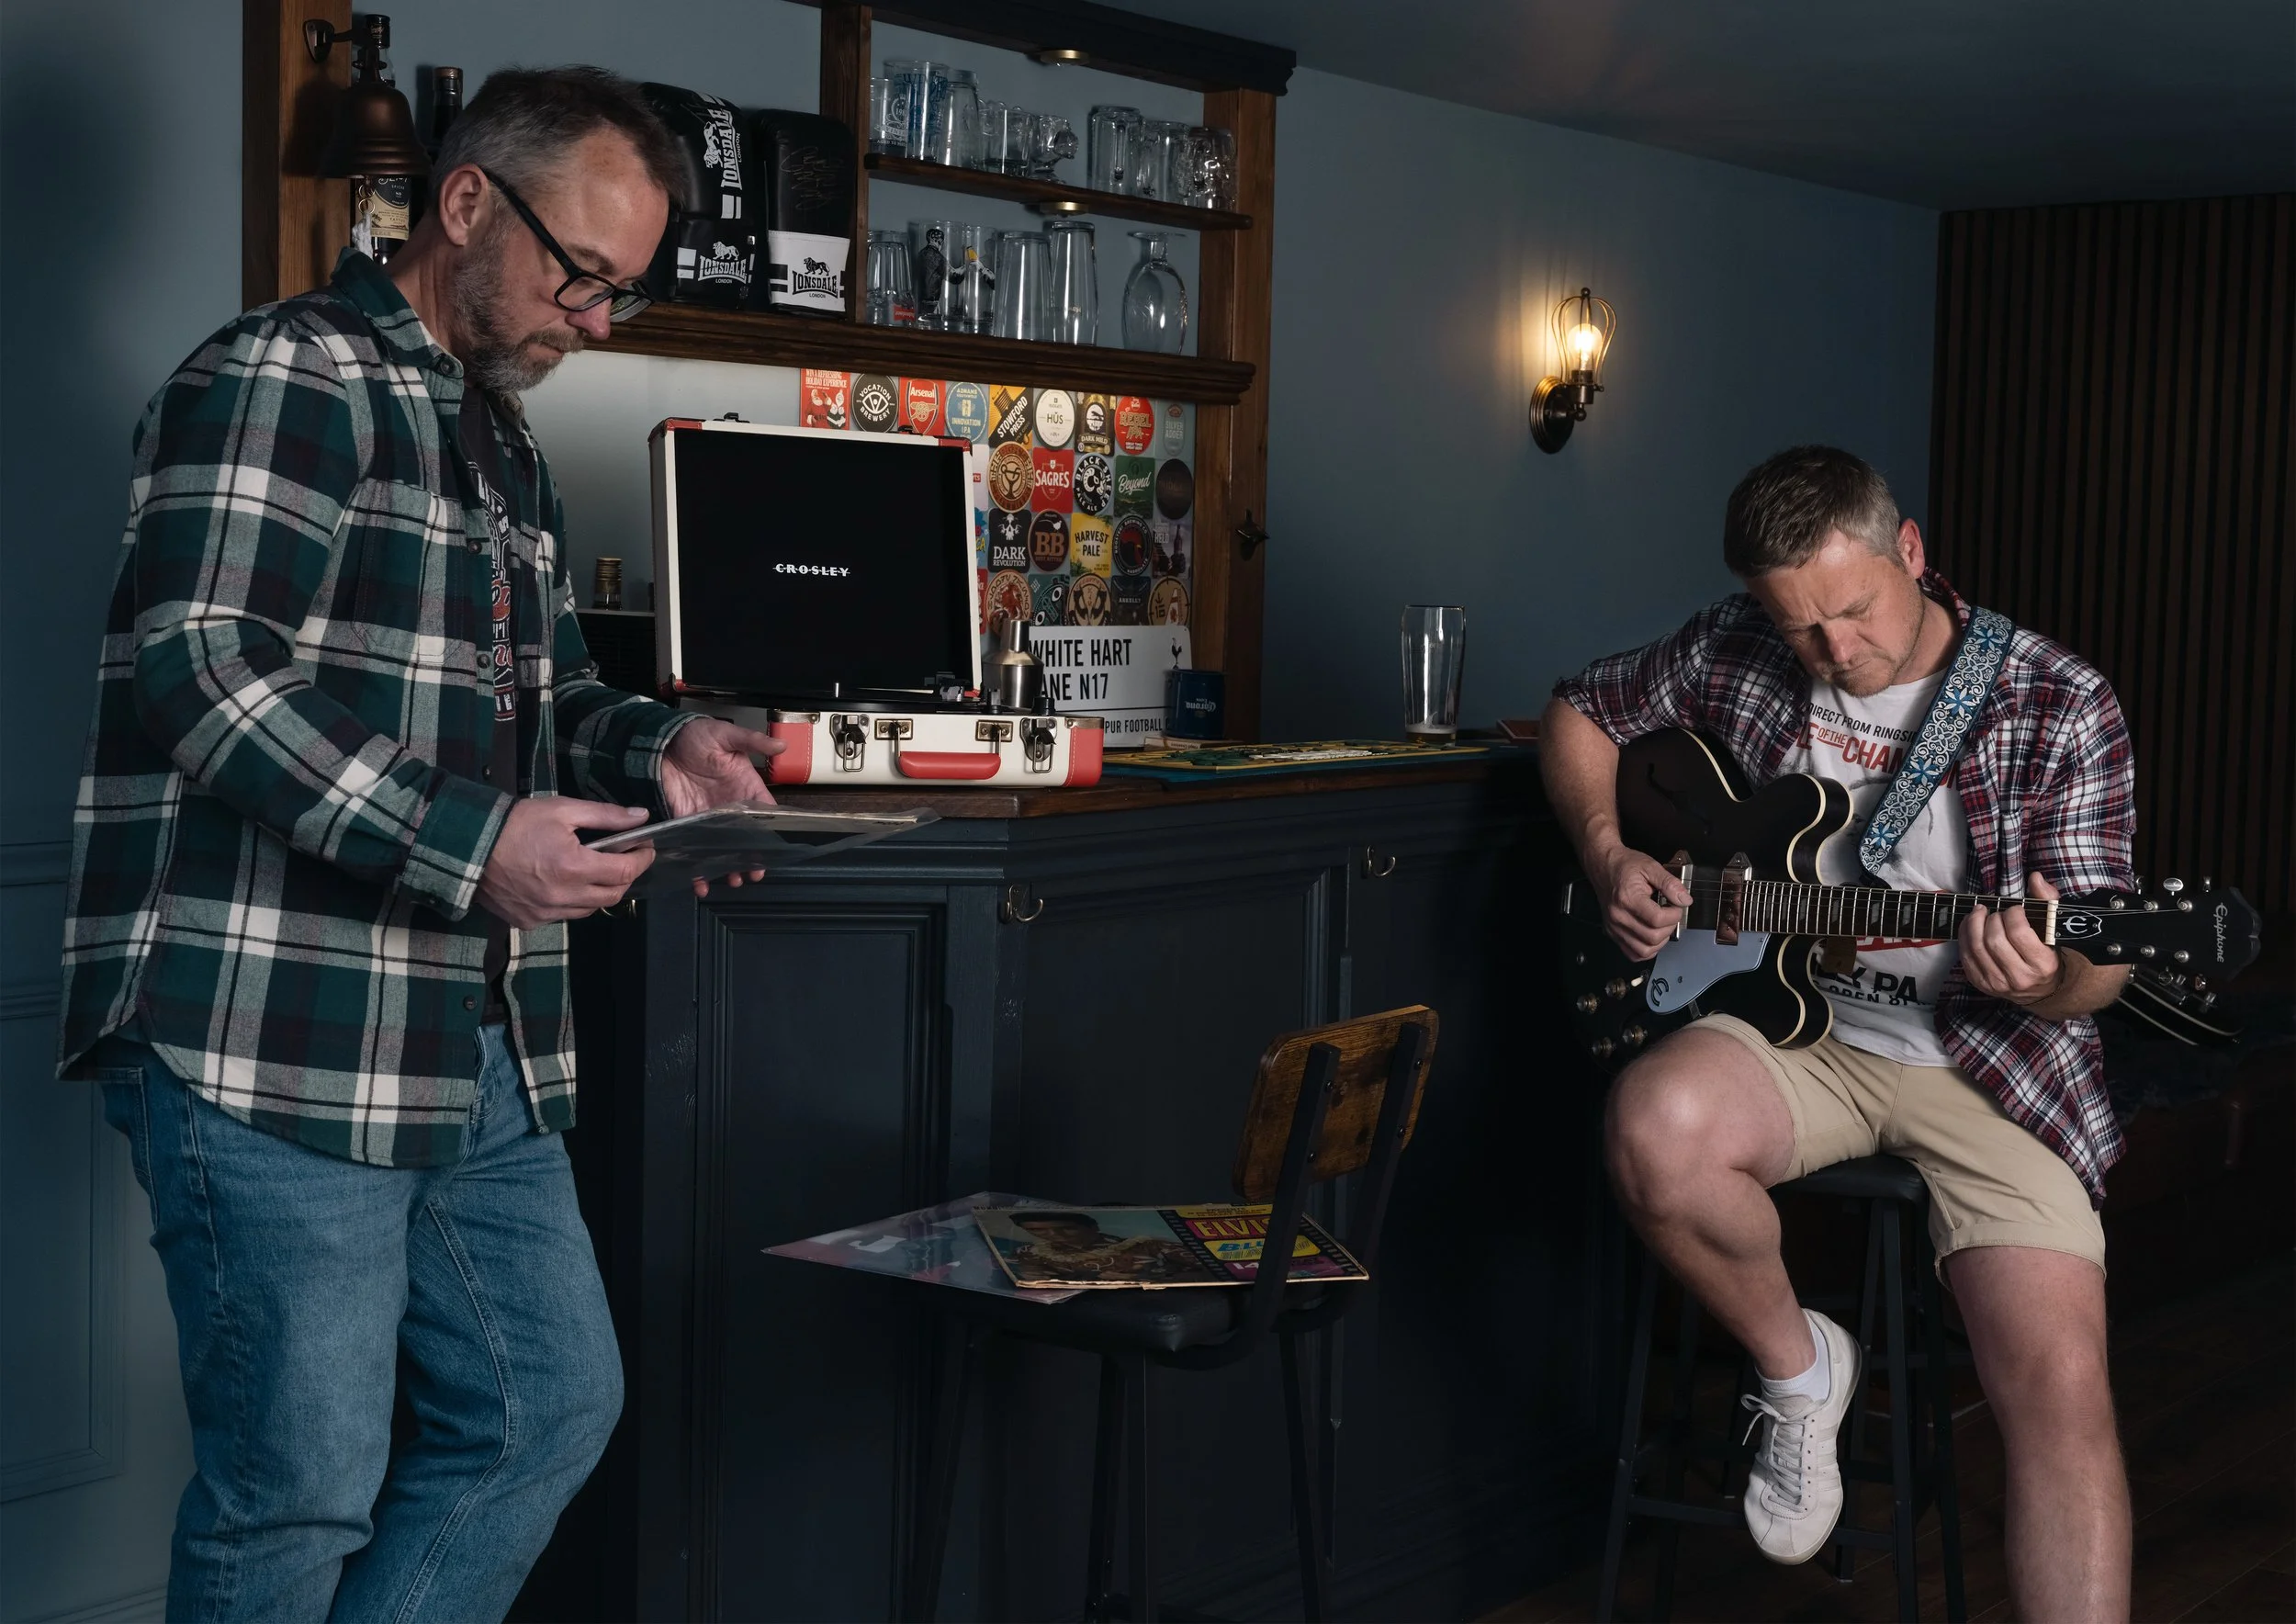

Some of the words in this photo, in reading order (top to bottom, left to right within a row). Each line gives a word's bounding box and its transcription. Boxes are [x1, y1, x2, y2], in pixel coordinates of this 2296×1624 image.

[708, 108, 742, 191] LONSDALE
[735, 132, 743, 163] LONDON
[698, 254, 748, 285] LONSDALE
[792, 270, 838, 299] LONSDALE
[859, 384, 892, 400] VOCATION
[910, 387, 935, 398] Arsenal
[860, 406, 891, 422] BREWERY
[996, 396, 1028, 438] STOWFORD
[1120, 411, 1152, 428] REBEL
[1009, 414, 1026, 436] PRESS
[1165, 421, 1184, 430] SILVER
[1096, 436, 1109, 445] MILD
[1165, 430, 1184, 440] ADDER
[1035, 469, 1070, 489] SAGRES
[1075, 457, 1100, 481] BLACK
[1101, 466, 1112, 508] SHEEP
[1118, 471, 1152, 496] Beyond
[1076, 487, 1086, 506] PALE
[1034, 531, 1065, 557] BB
[1075, 530, 1109, 544] HARVEST
[993, 546, 1026, 560] DARK
[1082, 544, 1100, 557] PALE
[775, 563, 850, 577] CROSLEY
[1029, 639, 1084, 668] WHITE
[1090, 638, 1132, 667] HART
[1041, 673, 1072, 701] ANE
[1080, 673, 1109, 700] N17
[1105, 720, 1121, 734] PUR
[1124, 718, 1163, 733] FOOTBALL
[1807, 703, 1842, 725] DIRECT
[1841, 715, 1872, 734] FROM
[1873, 725, 1919, 743] RINGSI
[1818, 727, 1831, 739] OF
[1829, 730, 1847, 745] THE
[2212, 902, 2228, 963] Epiphone
[1873, 971, 1919, 1003] PA
[1217, 1241, 1265, 1252] BLU
